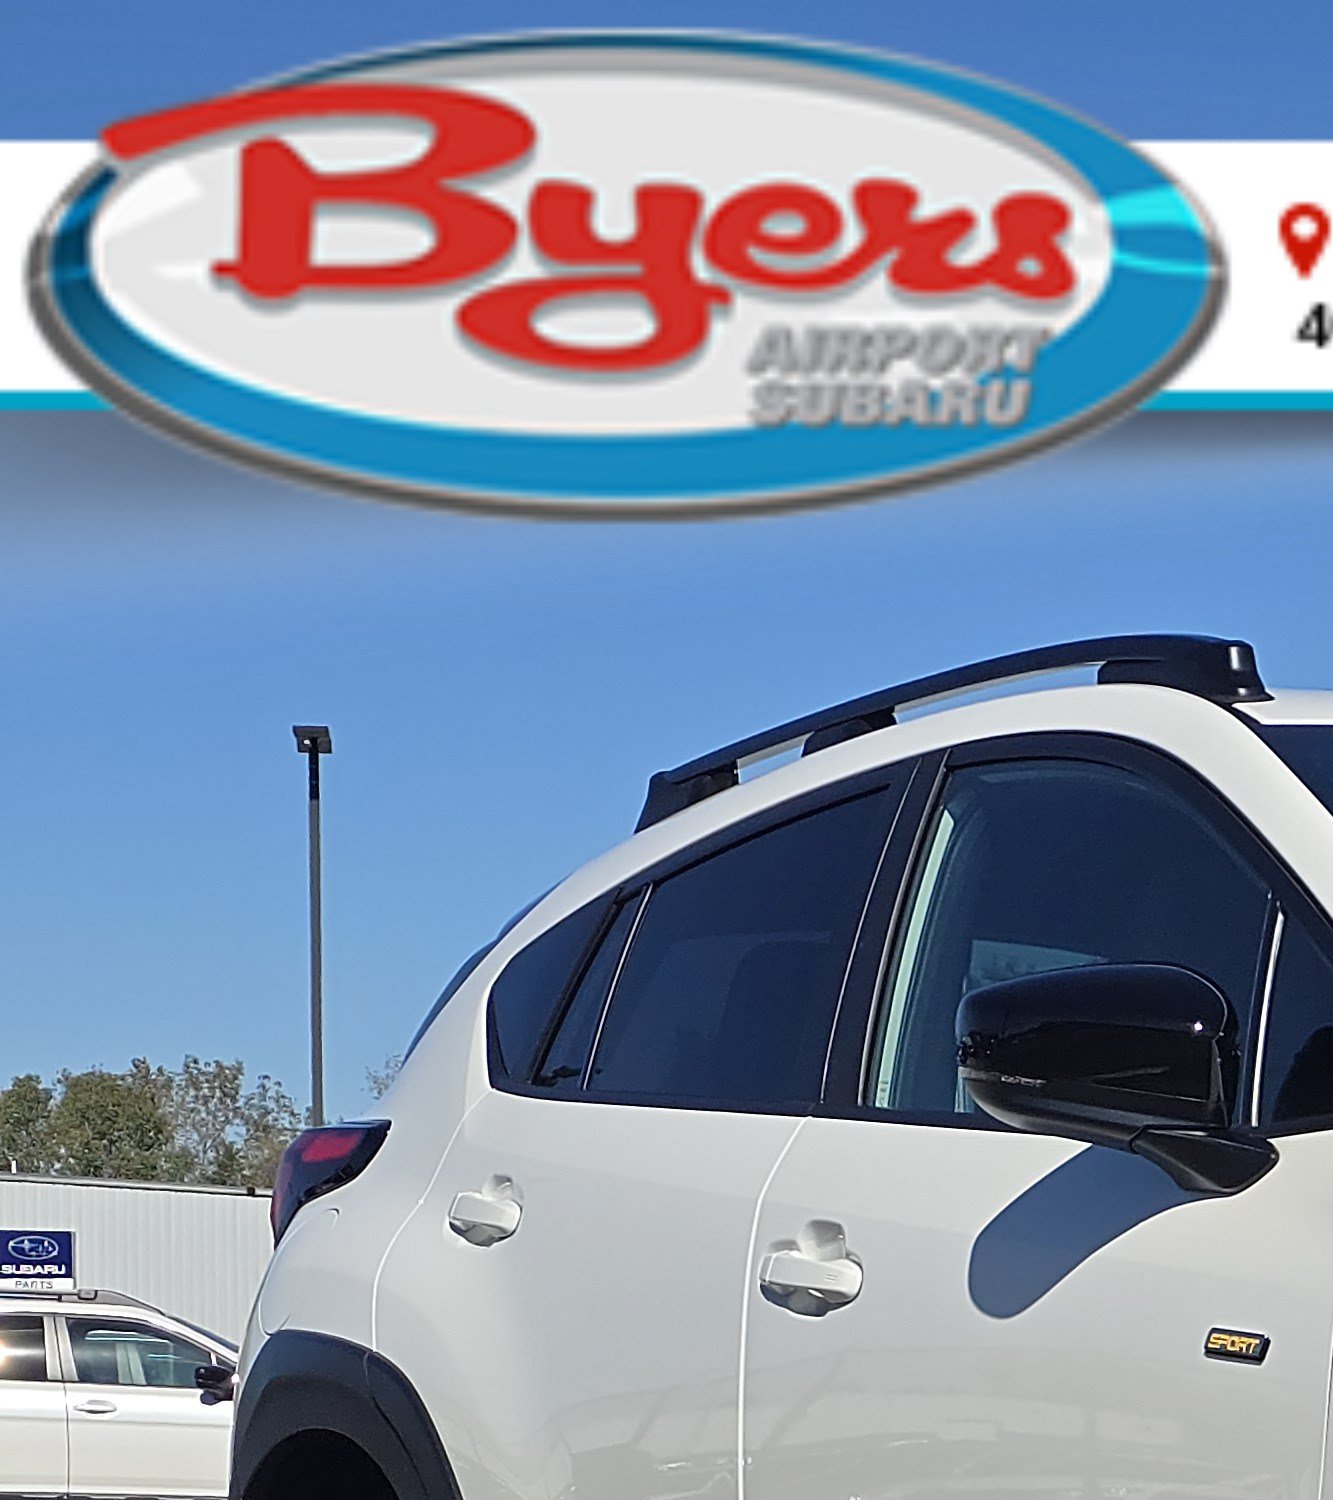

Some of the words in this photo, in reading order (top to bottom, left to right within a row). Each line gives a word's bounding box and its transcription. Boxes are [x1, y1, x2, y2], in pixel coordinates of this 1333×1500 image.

[0, 1264, 66, 1275] SUBARU
[15, 1280, 53, 1289] PARTS
[1207, 1332, 1260, 1354] SPORT
